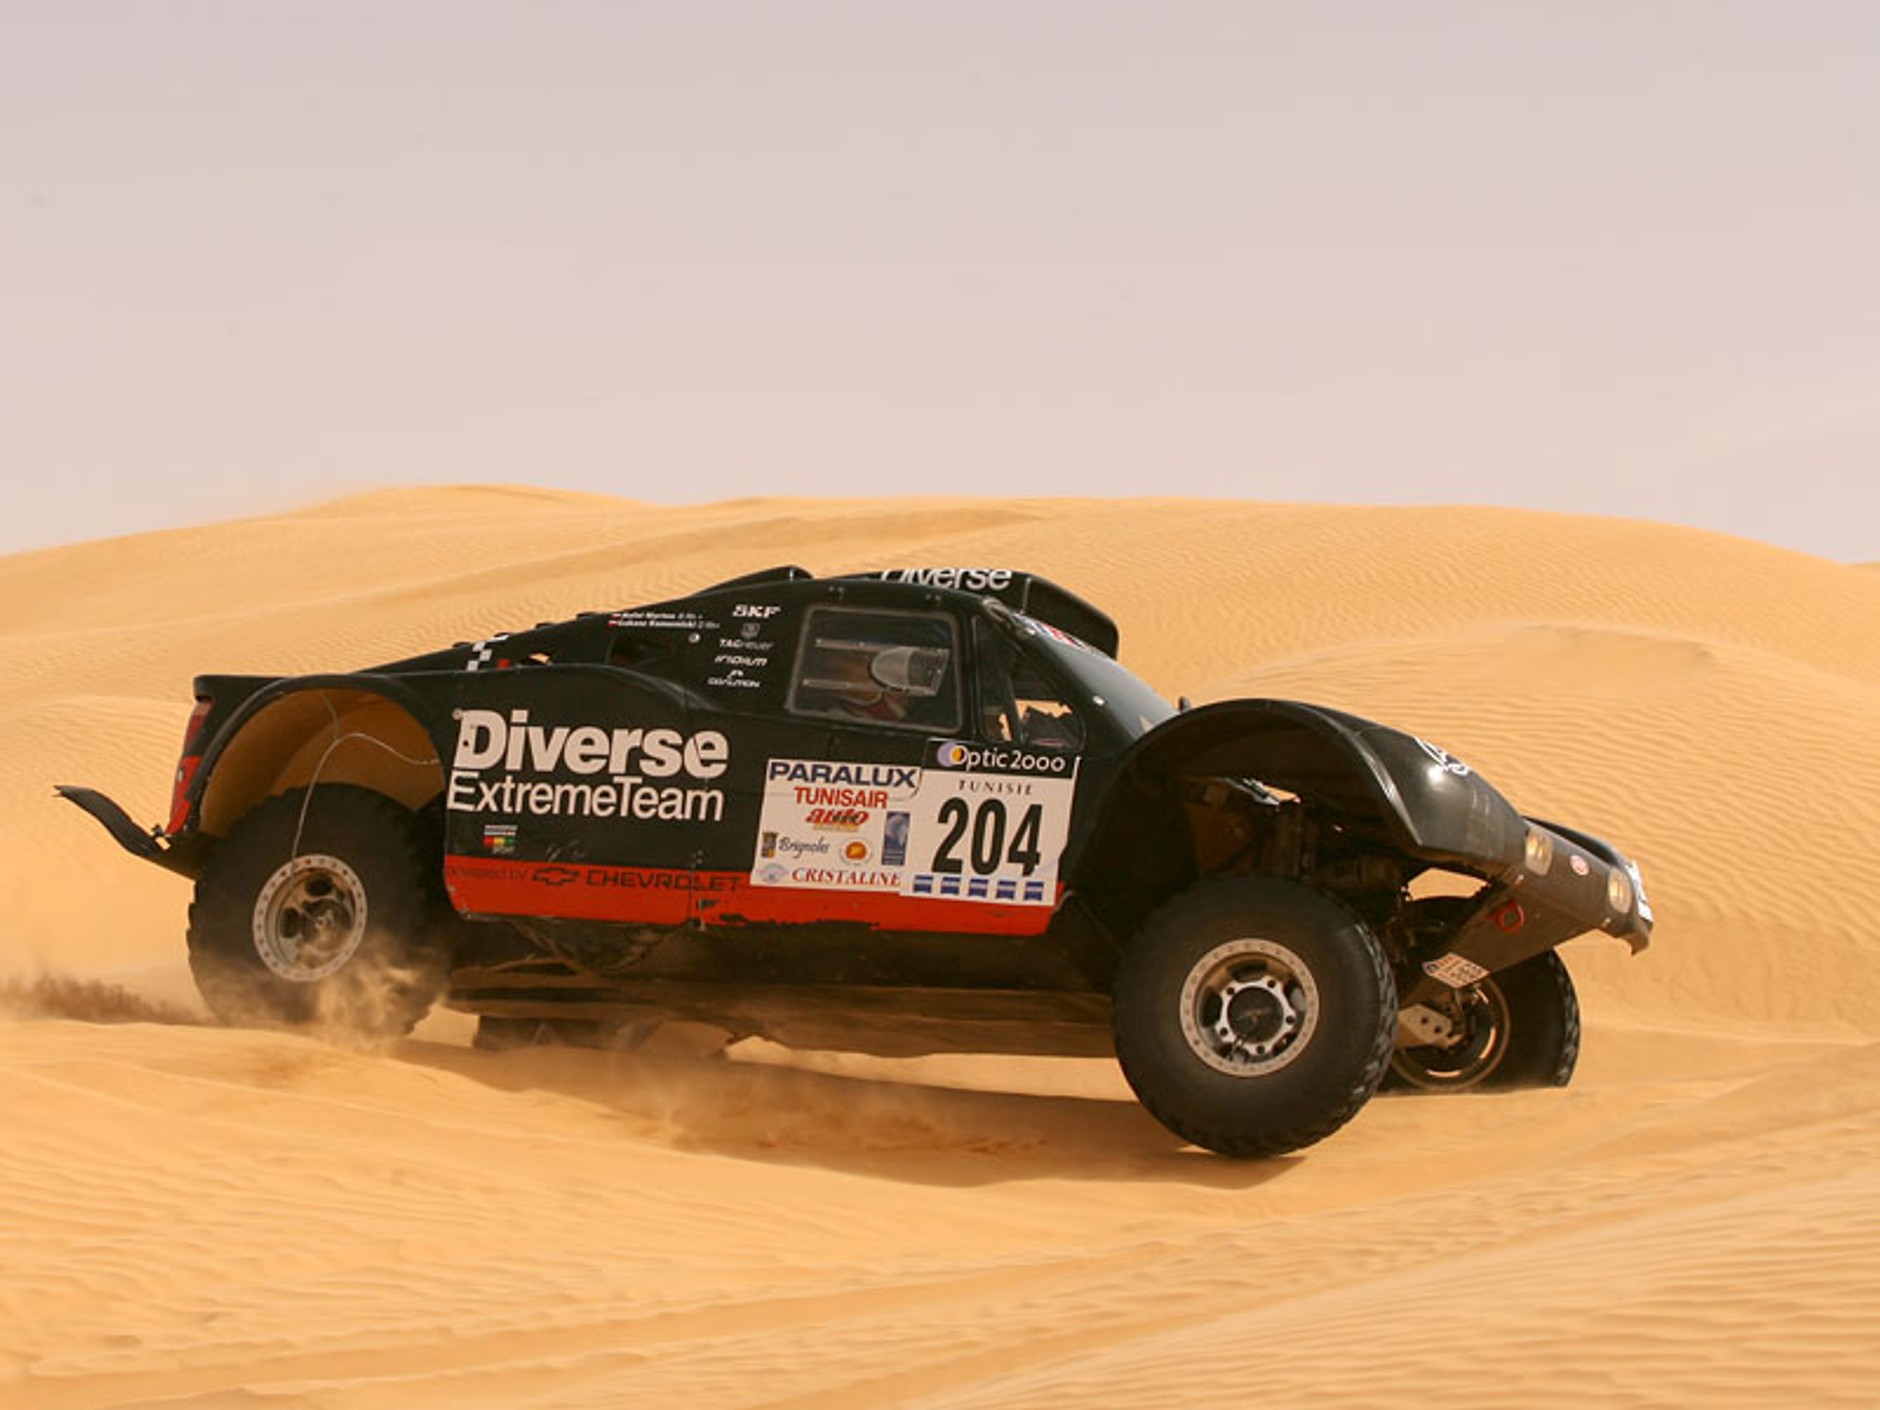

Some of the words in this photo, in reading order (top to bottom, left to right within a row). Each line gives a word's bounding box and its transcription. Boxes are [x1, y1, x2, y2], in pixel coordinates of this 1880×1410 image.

[732, 604, 781, 619] SKF
[453, 709, 730, 779] Diverse
[768, 761, 918, 788] PARALUX
[446, 770, 725, 822] ExtremeTeam
[793, 786, 889, 810] TUNISAIR
[958, 779, 1033, 796] TUNISIE
[805, 808, 870, 826] auto
[931, 796, 1043, 877] 204
[585, 869, 742, 893] CHEVROLET
[791, 866, 902, 887] CRISTALINE
